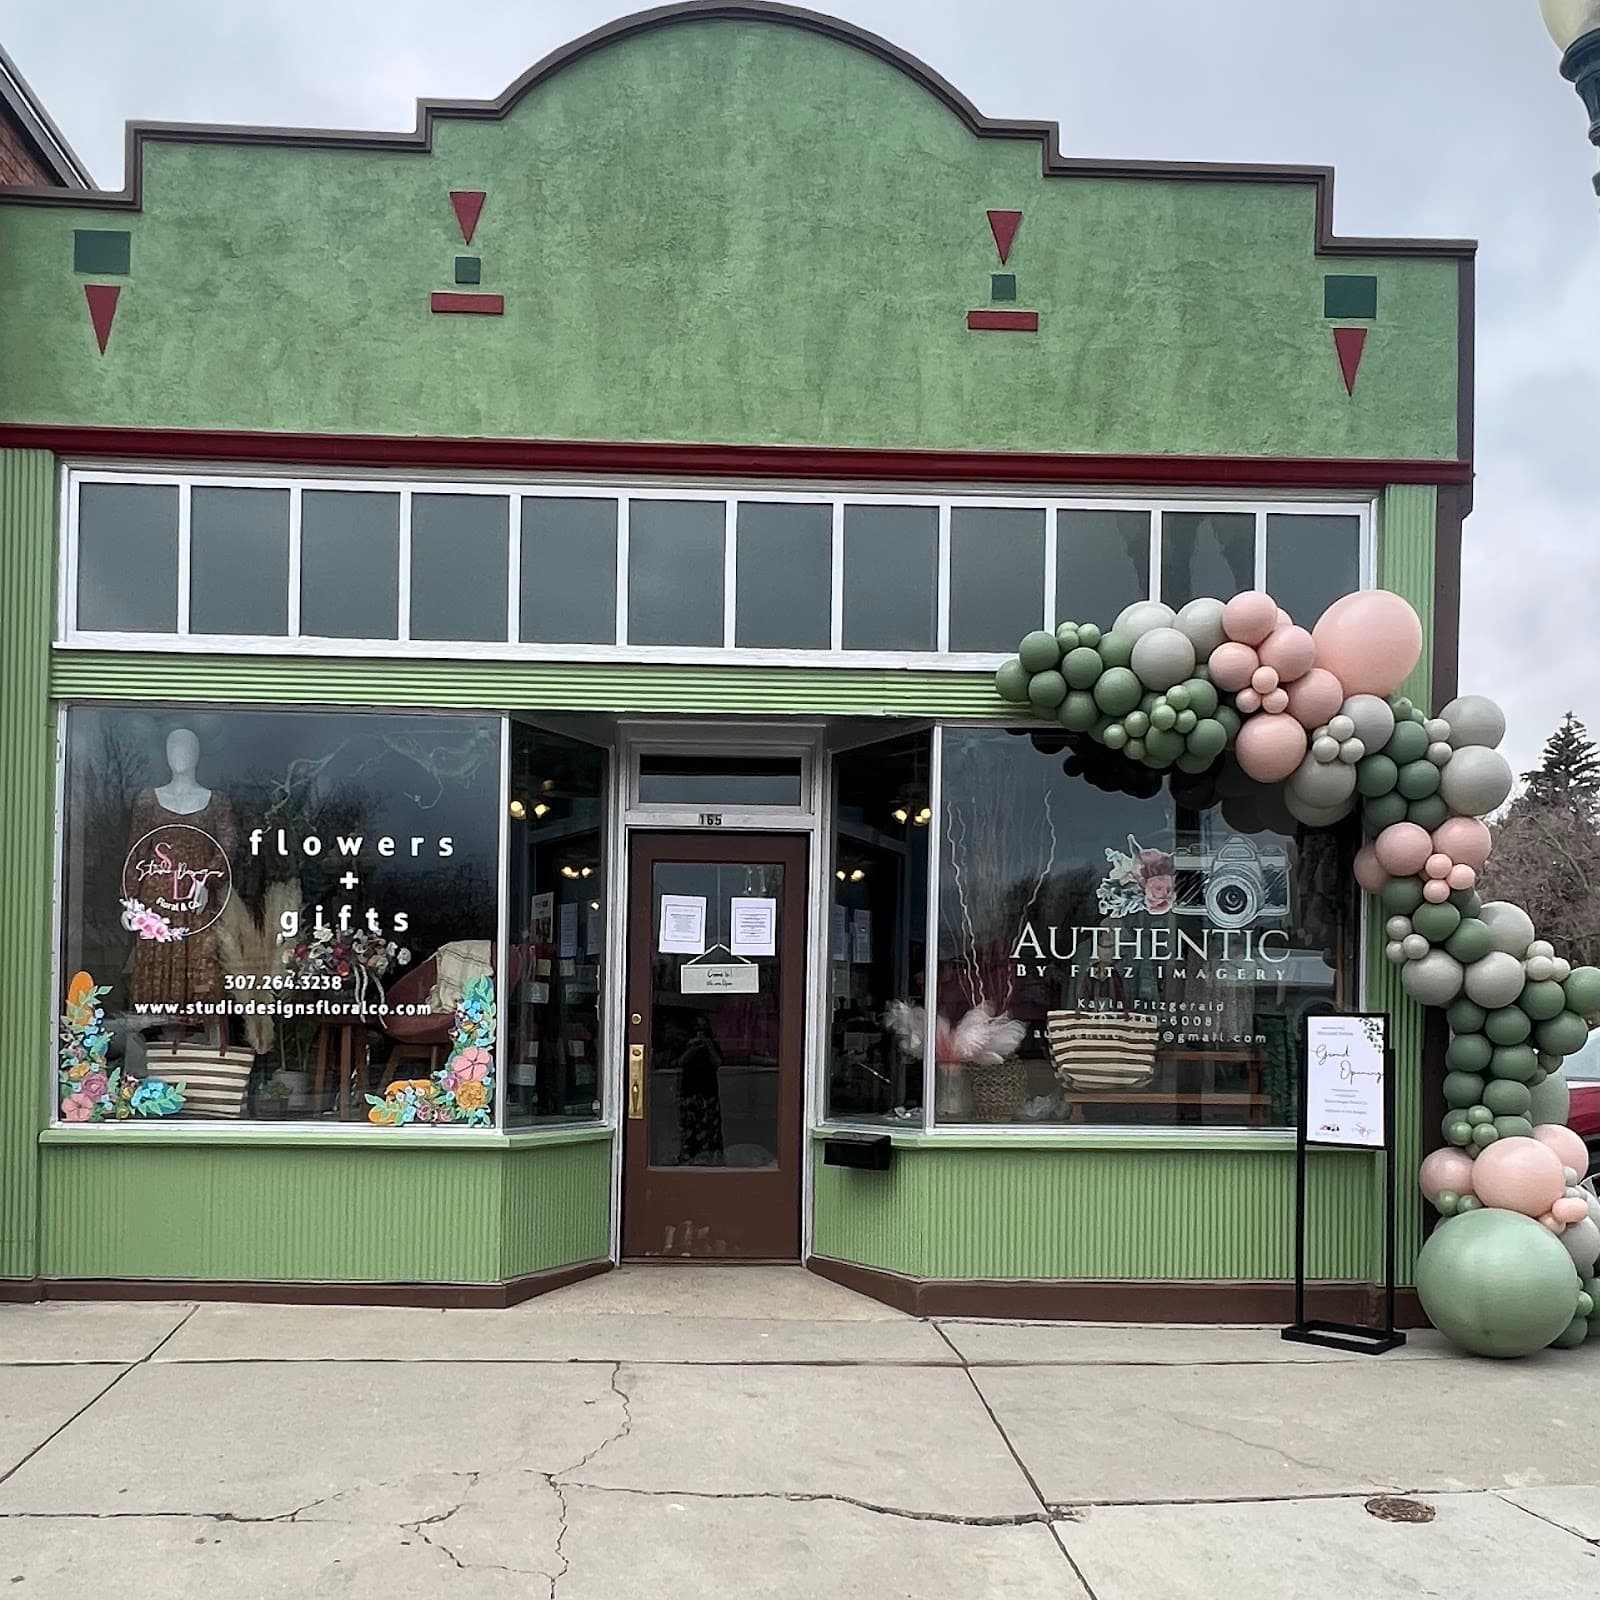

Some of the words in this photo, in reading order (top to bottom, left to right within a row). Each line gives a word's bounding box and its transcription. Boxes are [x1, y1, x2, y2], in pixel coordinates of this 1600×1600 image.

[700, 814, 722, 826] 165
[249, 829, 454, 857] flowers
[280, 905, 409, 937] gifts
[1009, 921, 1290, 963] AUTHENTIC
[1158, 966, 1285, 980] IMAGERY
[224, 974, 343, 990] 307.264.3238
[134, 1000, 432, 1018] www.studiodesignsfloralco.com
[1078, 998, 1124, 1011] Kayla
[1134, 1000, 1224, 1013] Fitzgerald
